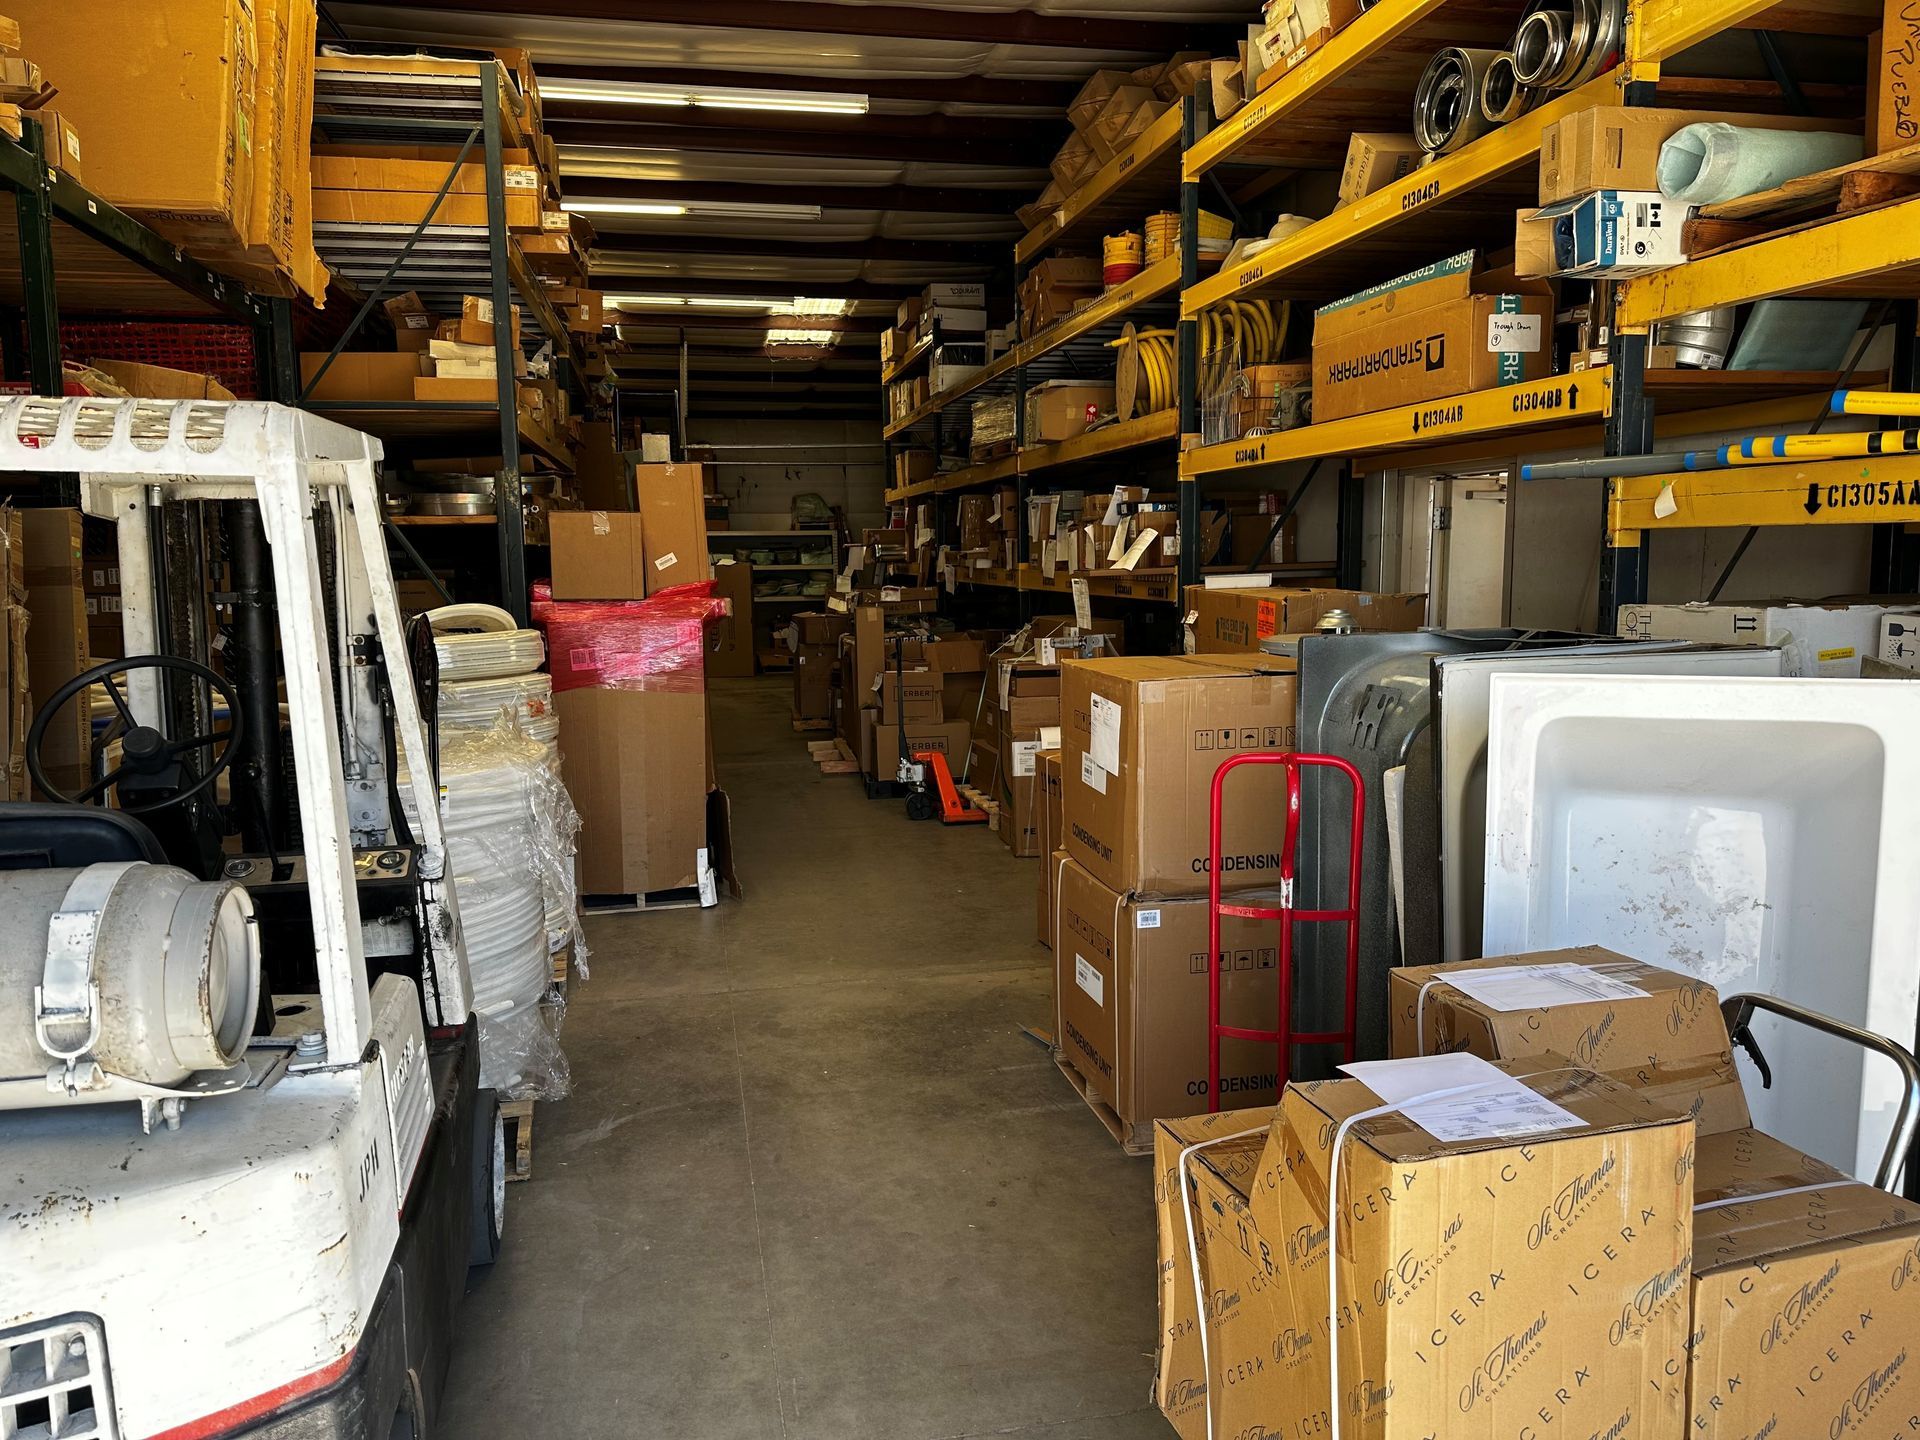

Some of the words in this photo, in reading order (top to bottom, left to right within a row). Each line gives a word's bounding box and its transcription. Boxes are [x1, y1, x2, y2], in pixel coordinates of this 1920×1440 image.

[1605, 221, 1613, 254] DuraVent
[1327, 340, 1423, 384] STANDARTPARK
[1072, 822, 1101, 856] CONDENSING
[1100, 842, 1112, 863] UNIT
[1066, 1021, 1099, 1066] CONDENSING
[1099, 1052, 1112, 1081] UNIT
[360, 1137, 379, 1203] JPH
[1258, 1150, 1306, 1195] ICERA
[1343, 1170, 1418, 1228] ICERA
[1553, 1150, 1615, 1221] Thomas
[1552, 1181, 1610, 1241] CREATIONS
[1396, 1244, 1457, 1305] CREATIONS
[1568, 1205, 1656, 1296] ICERA
[1634, 1248, 1693, 1317] Thomas
[1784, 1258, 1841, 1326] Thomas
[1415, 1269, 1506, 1363] ICERA
[1484, 1310, 1548, 1382] Thomas
[1782, 1286, 1835, 1345] CREATIONS
[1219, 1356, 1265, 1388] ICERA
[1485, 1341, 1542, 1403] CREATIONS
[1795, 1308, 1874, 1398] ICERA
[1853, 1347, 1907, 1413] Thomas
[1519, 1365, 1591, 1440] CERA
[1851, 1374, 1901, 1431] CREATIONS
